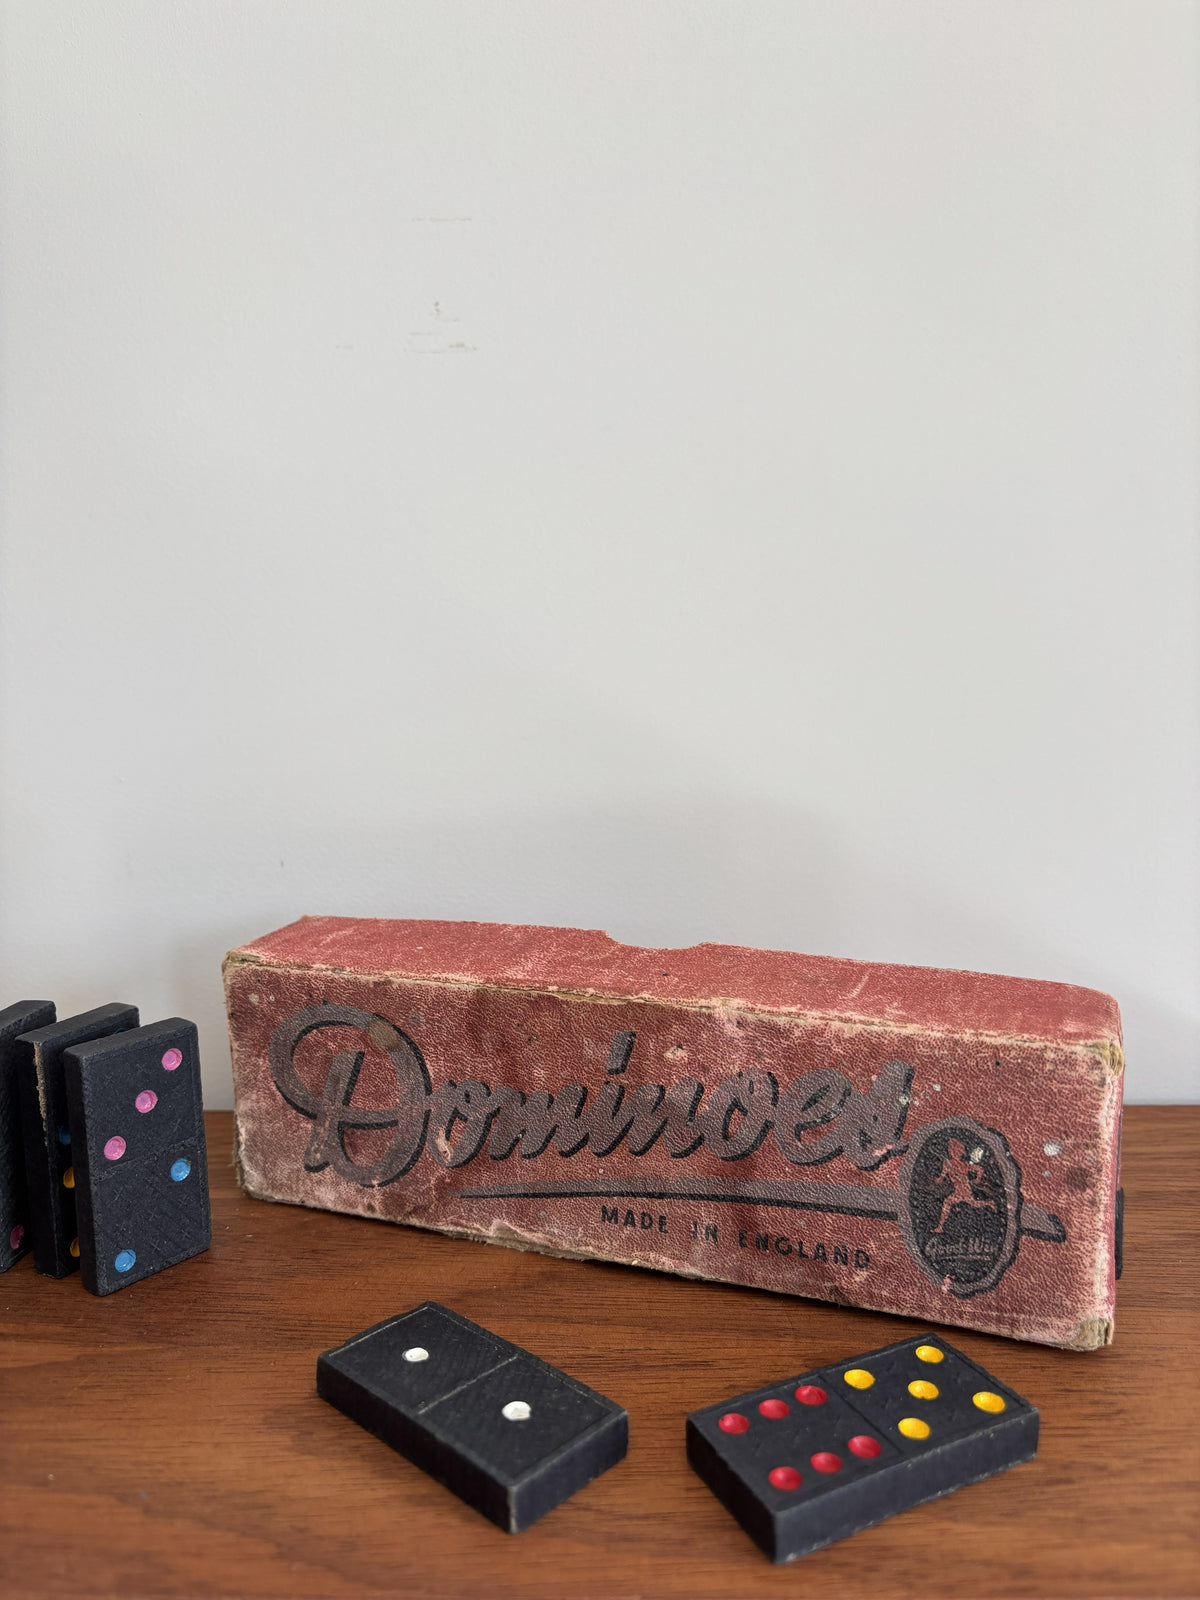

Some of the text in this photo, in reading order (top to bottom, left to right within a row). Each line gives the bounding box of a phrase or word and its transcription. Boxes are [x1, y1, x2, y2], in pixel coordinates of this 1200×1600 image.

[269, 1003, 914, 1188] Dominoes
[600, 1205, 871, 1269] MADE IN ENGLAND
